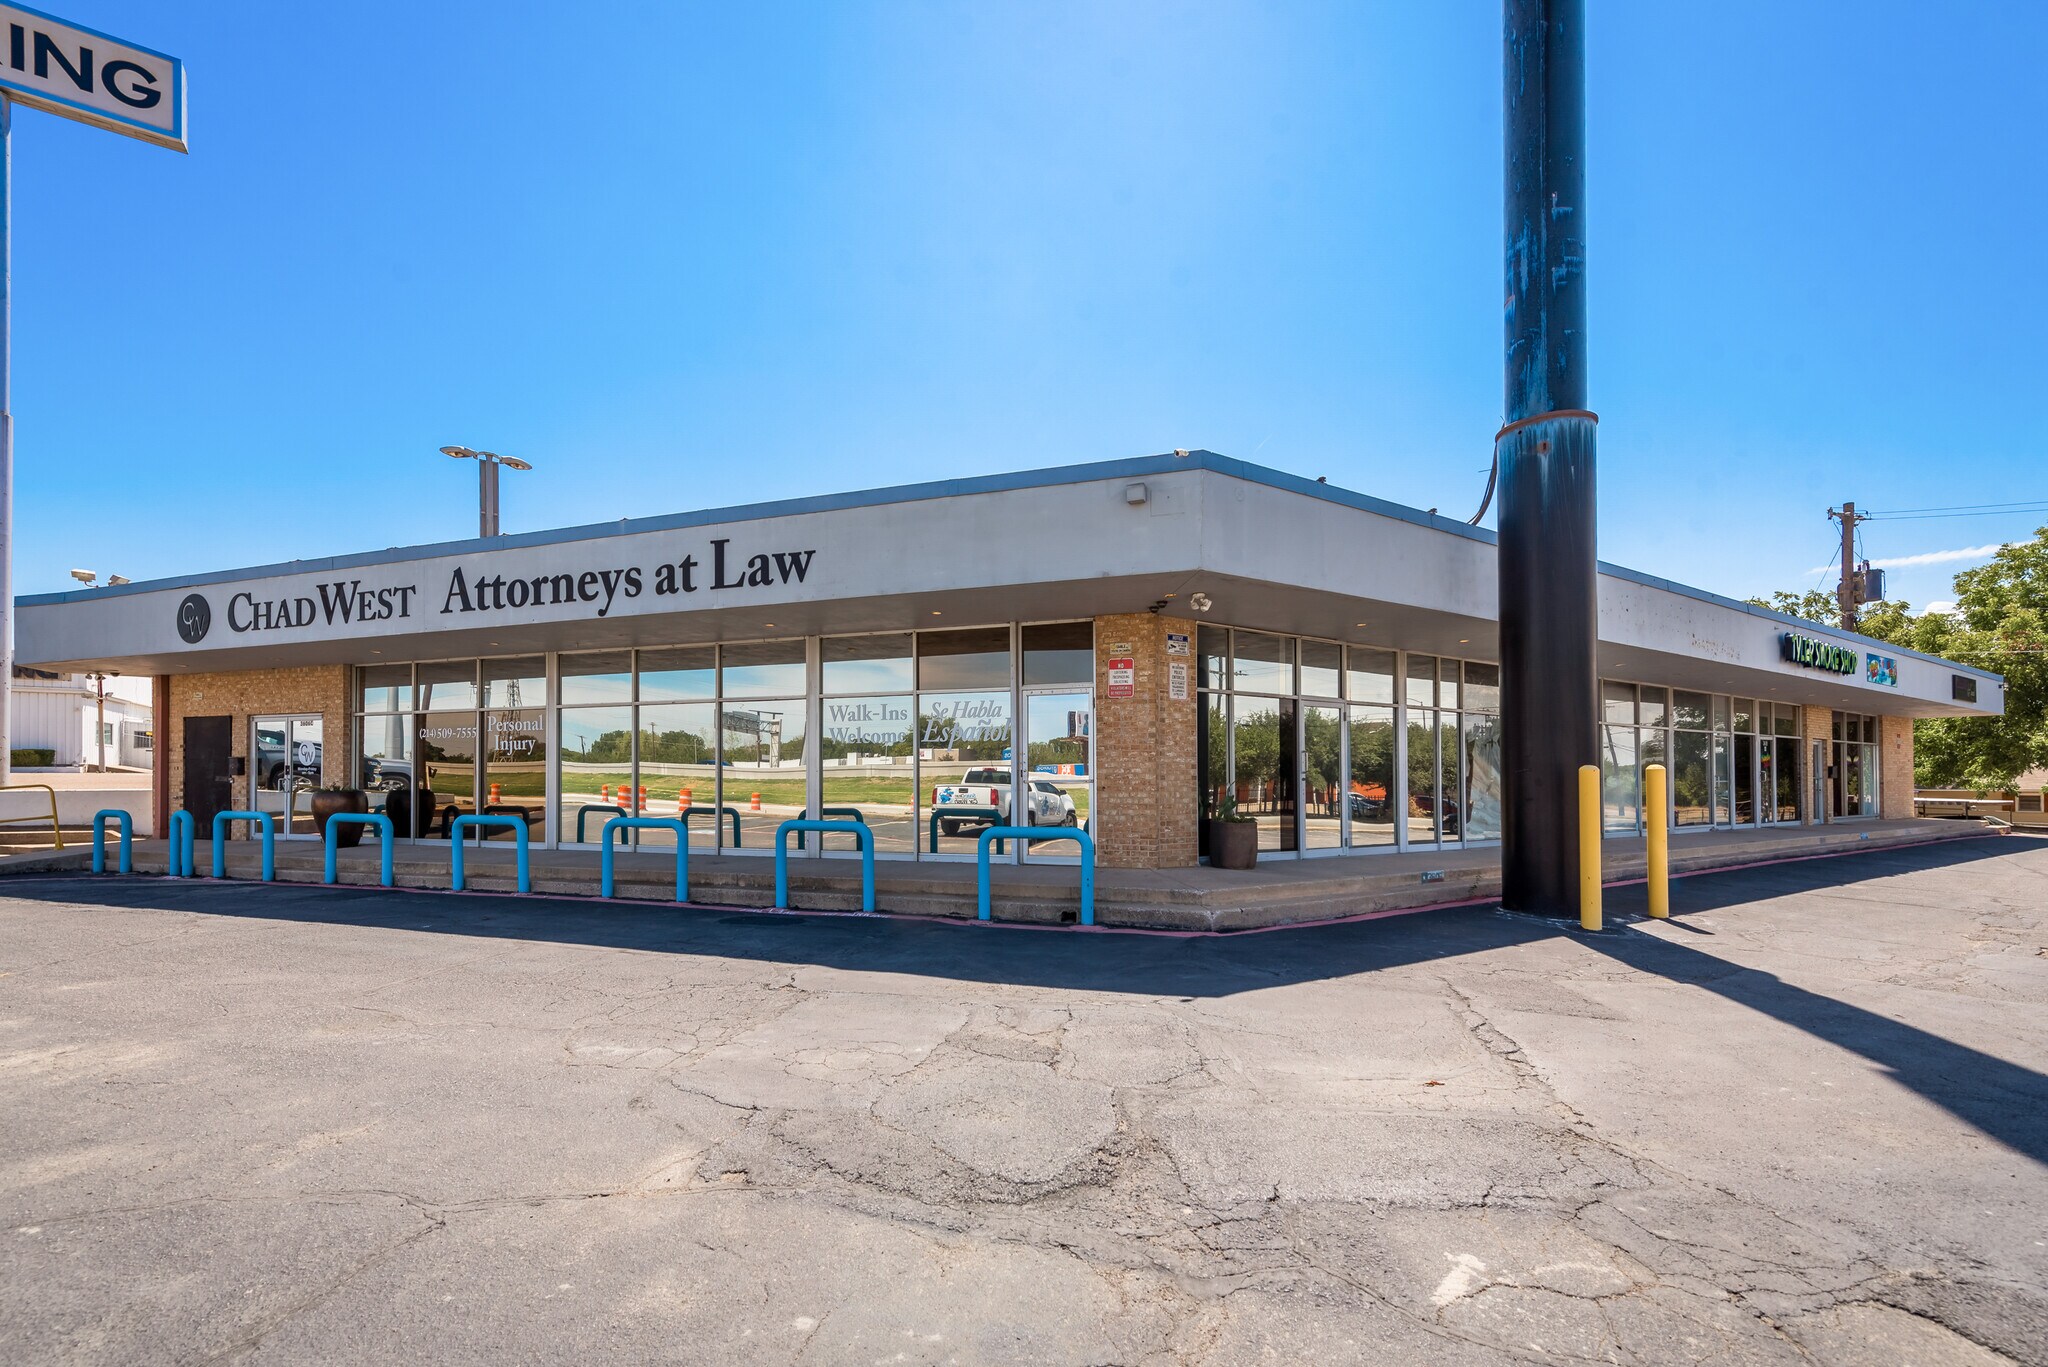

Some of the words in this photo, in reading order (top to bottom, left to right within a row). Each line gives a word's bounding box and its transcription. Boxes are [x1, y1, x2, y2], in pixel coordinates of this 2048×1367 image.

[0, 22, 161, 109] ING
[440, 566, 643, 617] Attorneys
[655, 554, 698, 596] at
[710, 539, 816, 590] Law
[227, 592, 316, 633] CHAD
[316, 580, 416, 626] WEST
[1814, 639, 1840, 672] SMOKE
[1840, 647, 1859, 675] SHOP
[829, 703, 908, 722] Walk-Ins
[931, 702, 949, 719] Se
[952, 700, 1003, 719] Habla
[419, 727, 477, 739] (214)509-7555
[487, 715, 544, 732] Personal
[829, 727, 907, 745] Welcome
[921, 717, 1011, 752] Español
[494, 735, 536, 756] Injury
